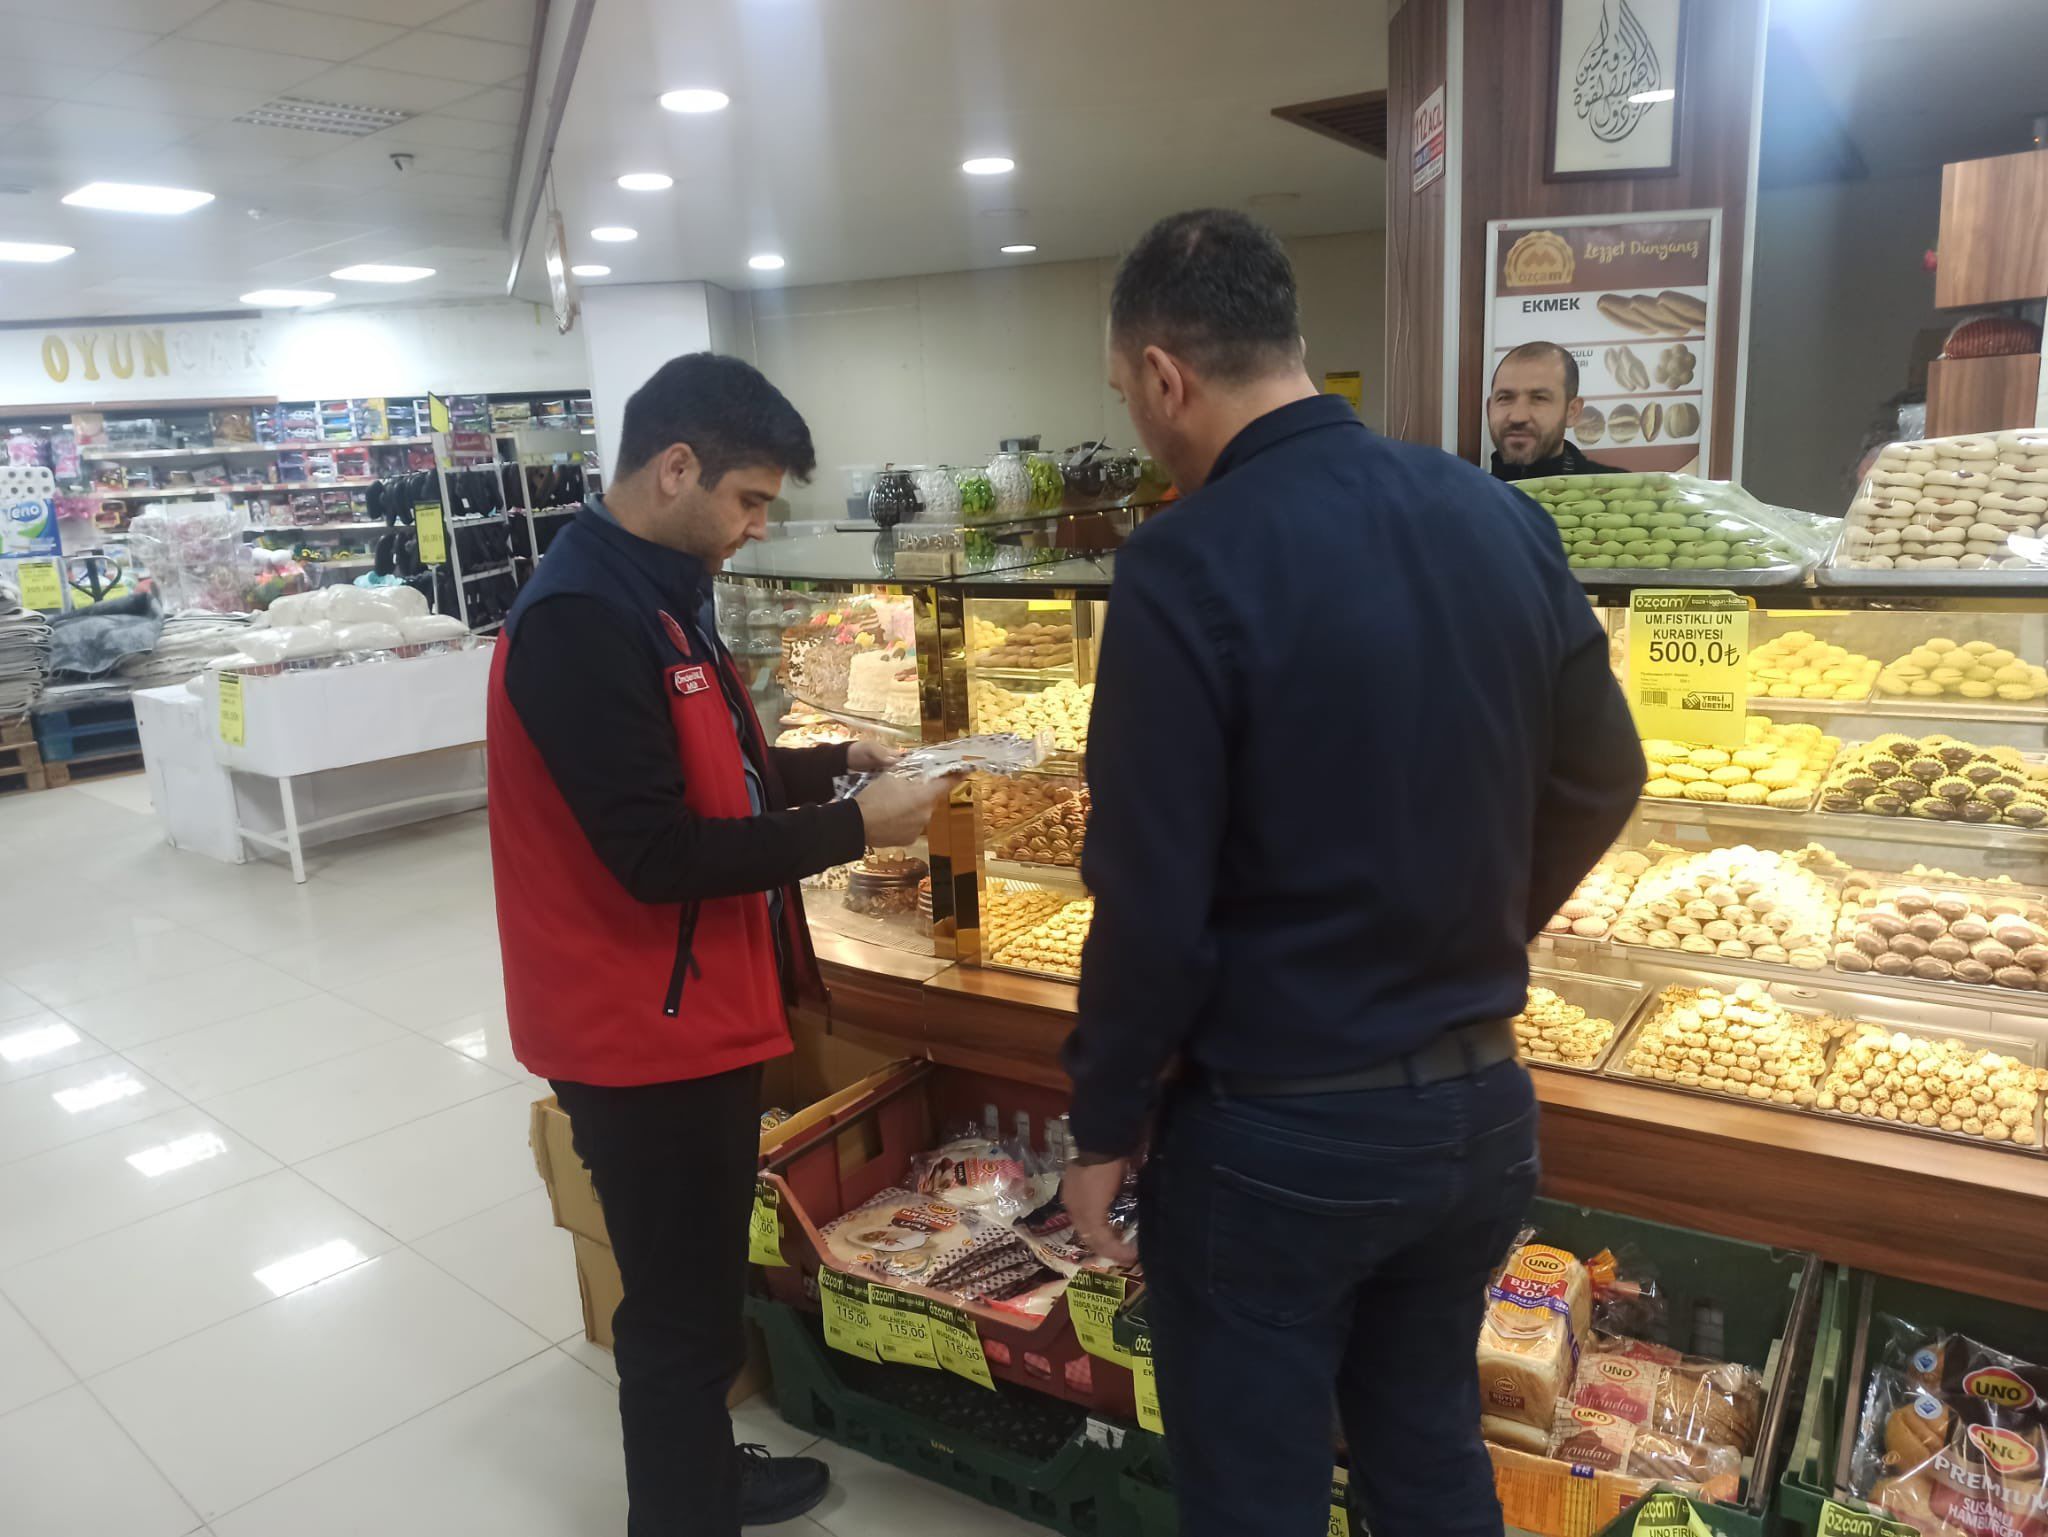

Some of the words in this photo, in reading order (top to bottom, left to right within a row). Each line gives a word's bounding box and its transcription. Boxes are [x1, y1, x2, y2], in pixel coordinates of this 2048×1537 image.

[1584, 241, 1625, 264] Lezzet
[1522, 298, 1580, 313] EKMEK
[1636, 596, 1684, 611] özçam
[1716, 614, 1733, 625] UN
[930, 1204, 954, 1214] UNO
[1528, 1258, 1559, 1270] UNO
[822, 1272, 844, 1291] özçam
[872, 1288, 896, 1305] özçam
[1517, 1287, 1551, 1299] TOST
[929, 1302, 954, 1322] özçam
[1135, 1335, 1152, 1356] özç
[1602, 1363, 1632, 1378] UNO
[1975, 1379, 2022, 1401] UNO
[1577, 1409, 1608, 1421] UNO
[1825, 1509, 1874, 1537] özçam
